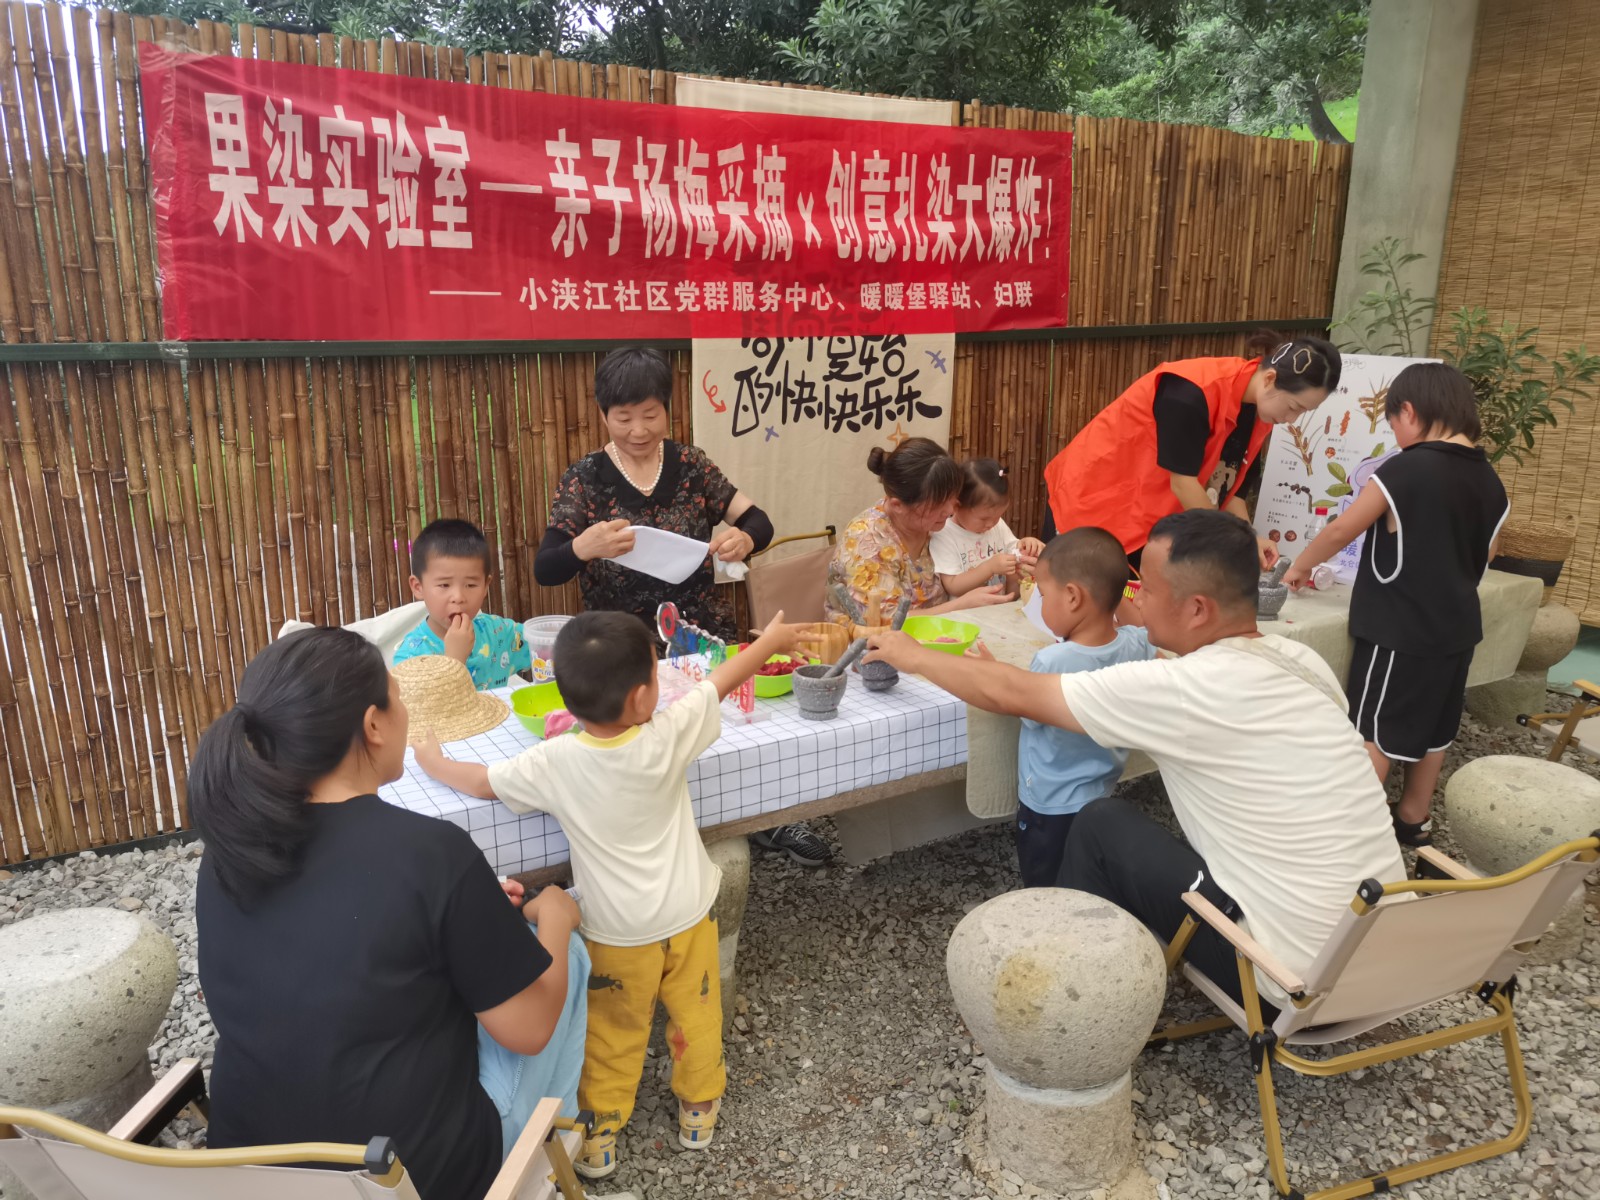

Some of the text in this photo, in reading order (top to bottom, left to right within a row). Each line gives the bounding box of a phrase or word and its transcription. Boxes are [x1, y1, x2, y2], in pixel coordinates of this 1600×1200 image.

[518, 277, 1034, 313] 小浃江社区党群服务中心、暖暖堡驿站、妇联
[732, 360, 943, 437] 的快快乐乐
